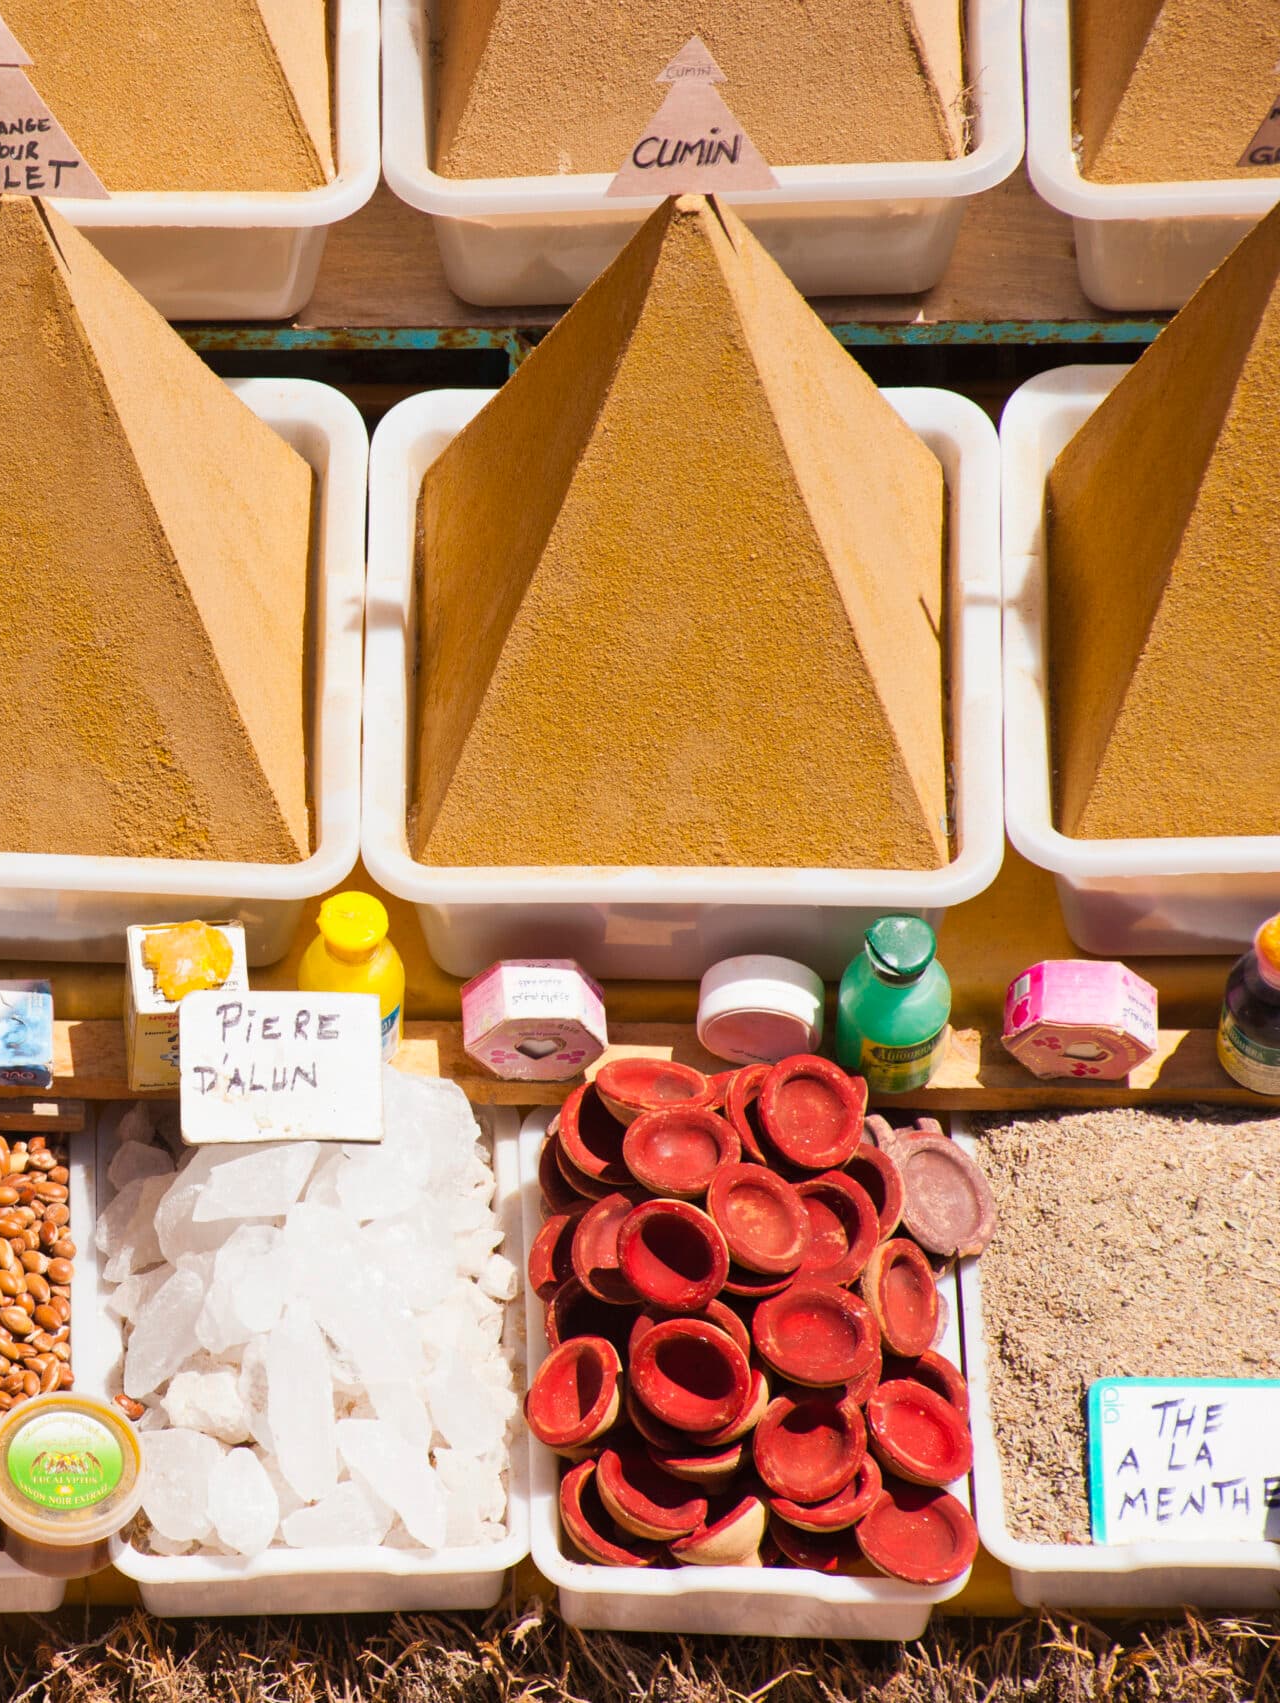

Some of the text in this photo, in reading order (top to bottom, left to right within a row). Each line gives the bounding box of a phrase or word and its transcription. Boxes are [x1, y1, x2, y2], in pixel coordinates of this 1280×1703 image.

[192, 1053, 319, 1096] D'ALUN
[1151, 1398, 1228, 1438] THE
[1117, 1440, 1213, 1475] A LA
[49, 1495, 72, 1505] NOIR
[1118, 1476, 1280, 1522] MENTHE
